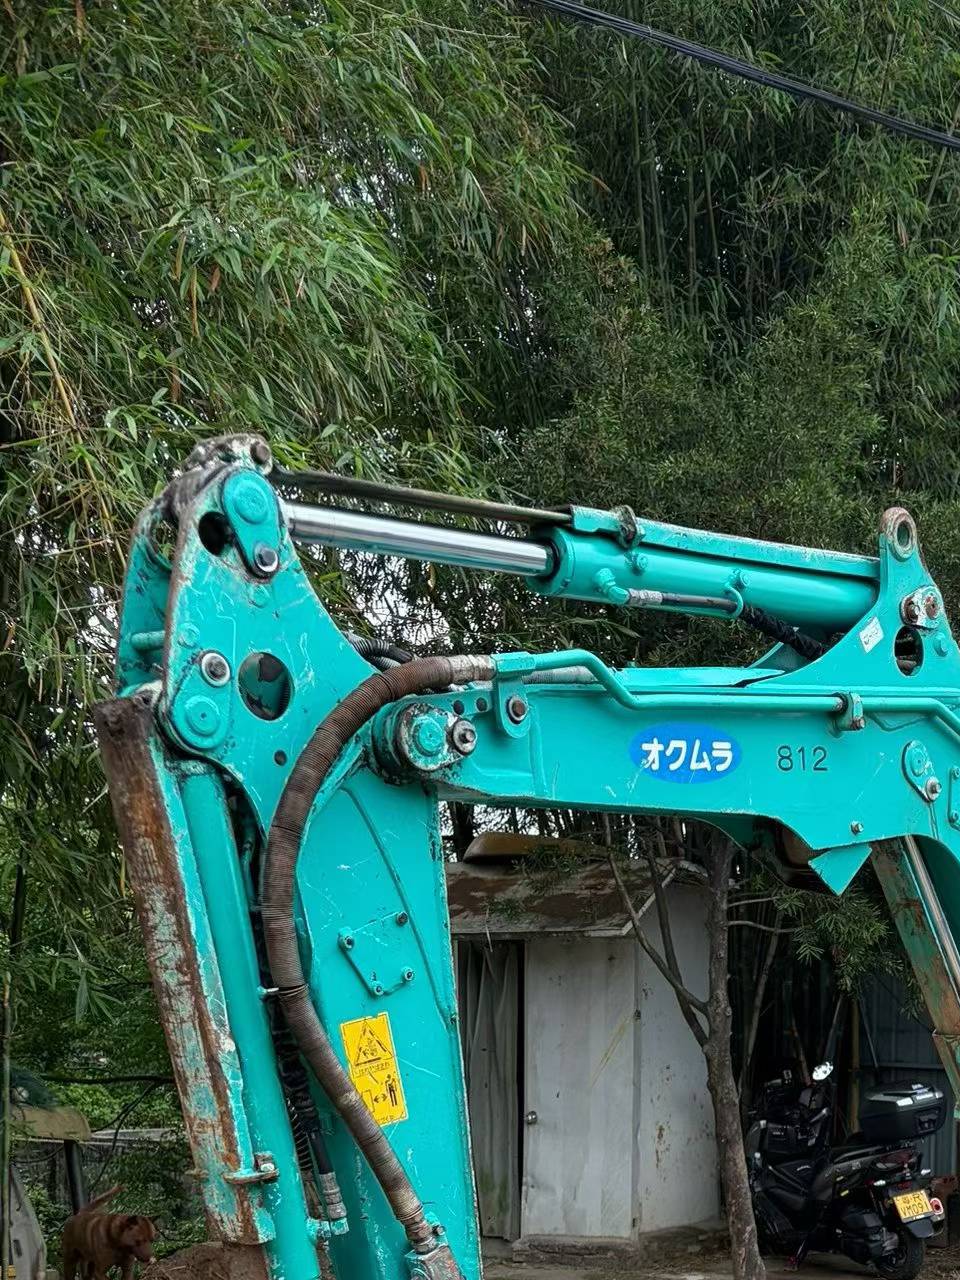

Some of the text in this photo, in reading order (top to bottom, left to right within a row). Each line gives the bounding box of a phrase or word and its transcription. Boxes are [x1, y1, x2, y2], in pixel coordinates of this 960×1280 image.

[641, 737, 733, 772] オクムラ
[777, 745, 828, 772] 812
